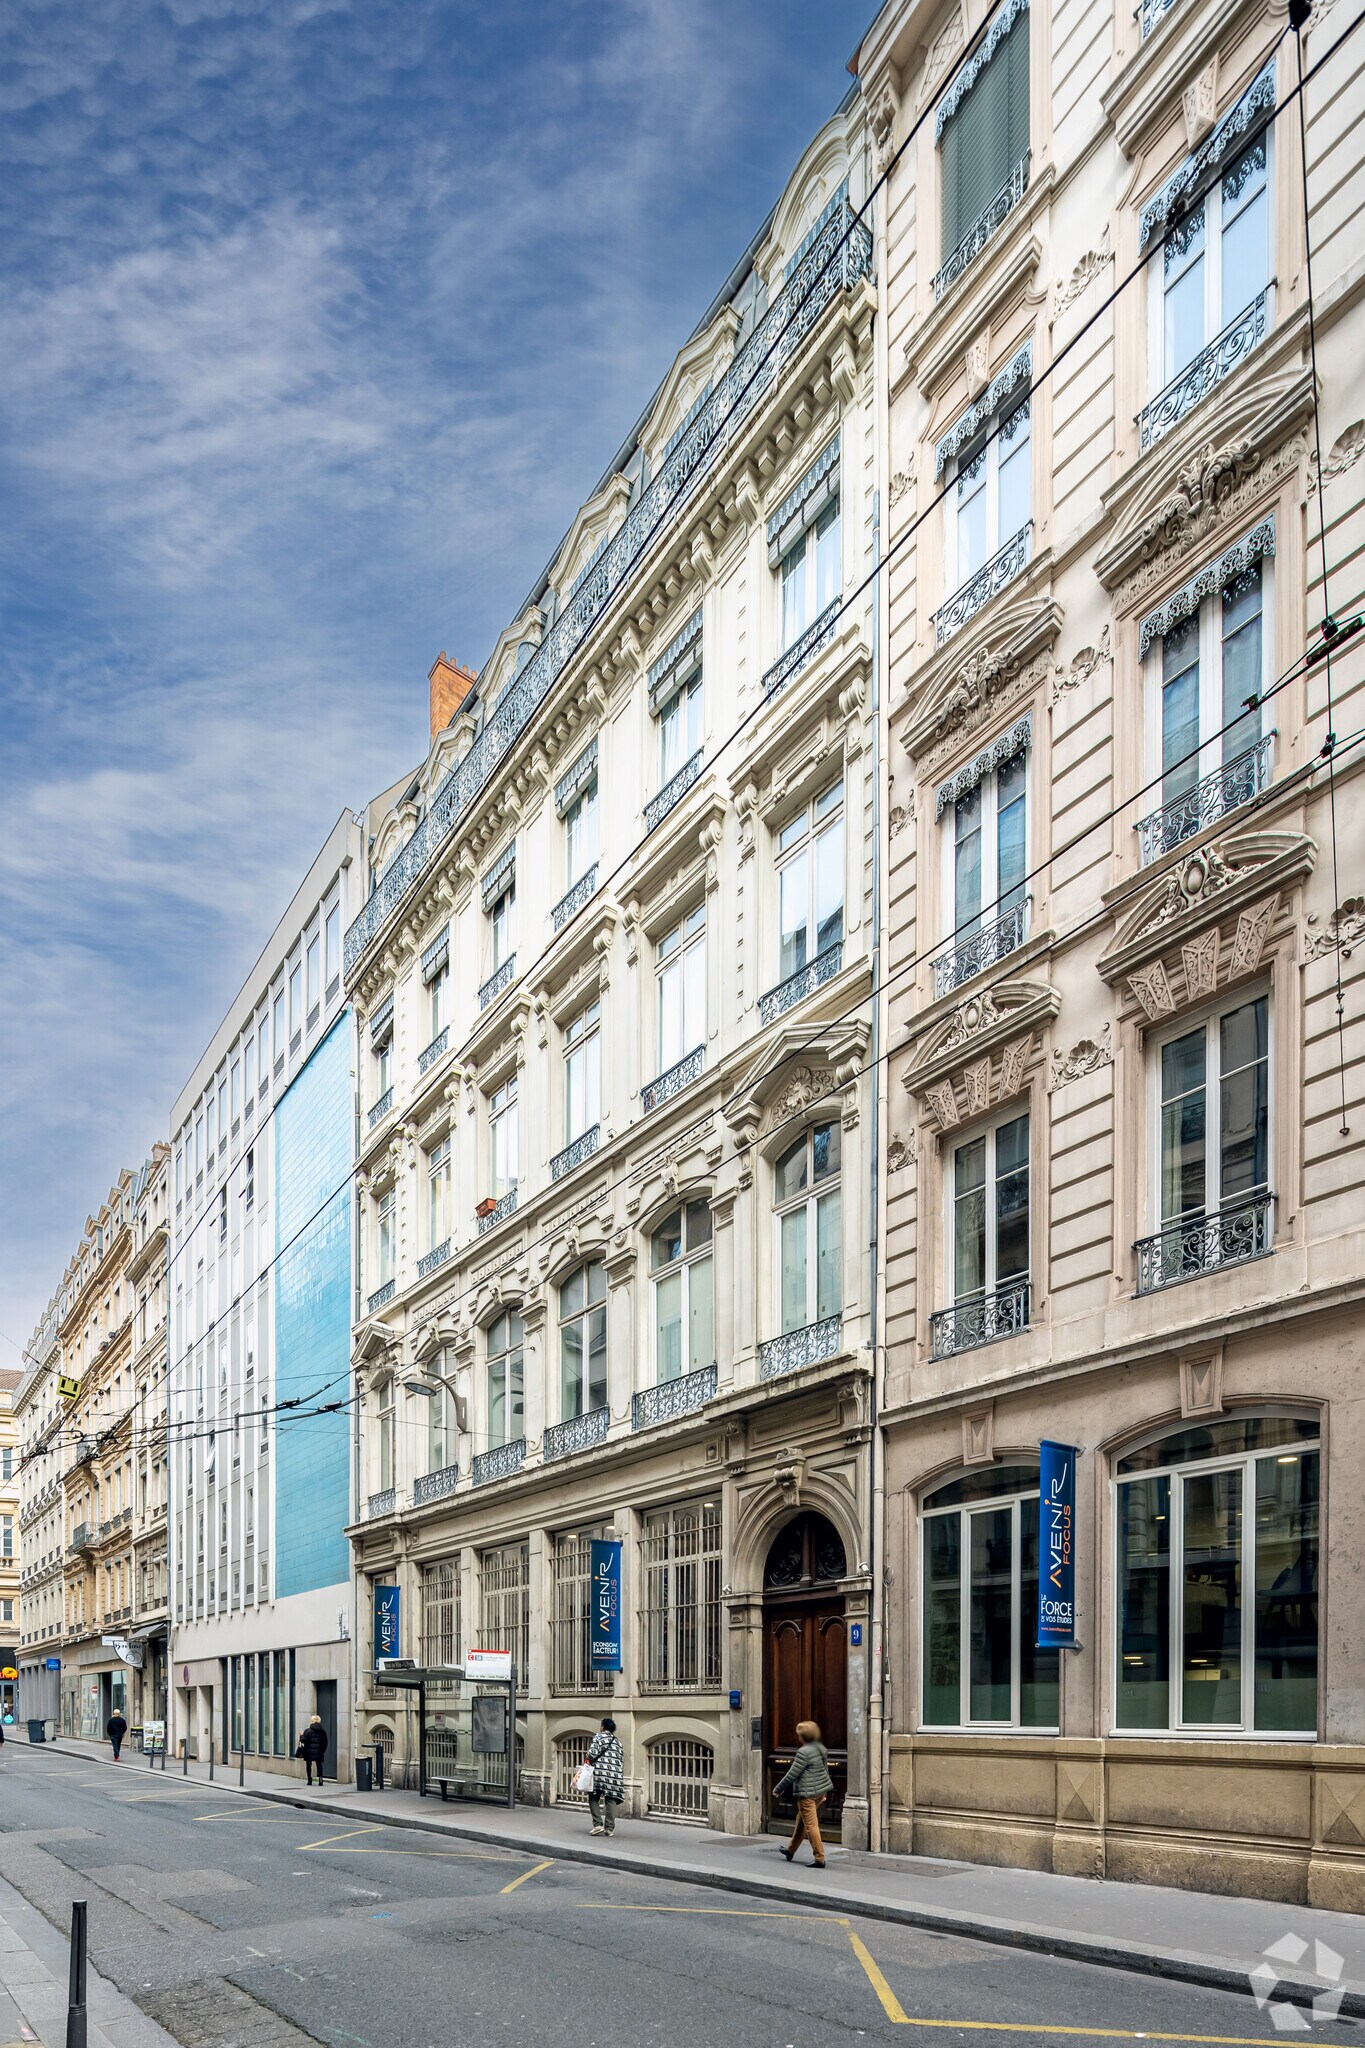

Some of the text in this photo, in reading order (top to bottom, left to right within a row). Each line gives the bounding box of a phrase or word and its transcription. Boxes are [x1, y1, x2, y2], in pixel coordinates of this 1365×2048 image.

[1063, 1505, 1071, 1565] FOCUS
[1040, 1593, 1047, 1601] LA
[1040, 1600, 1072, 1617] FORCE
[1056, 1615, 1073, 1625] ÉTUDES
[853, 1630, 860, 1640] 9
